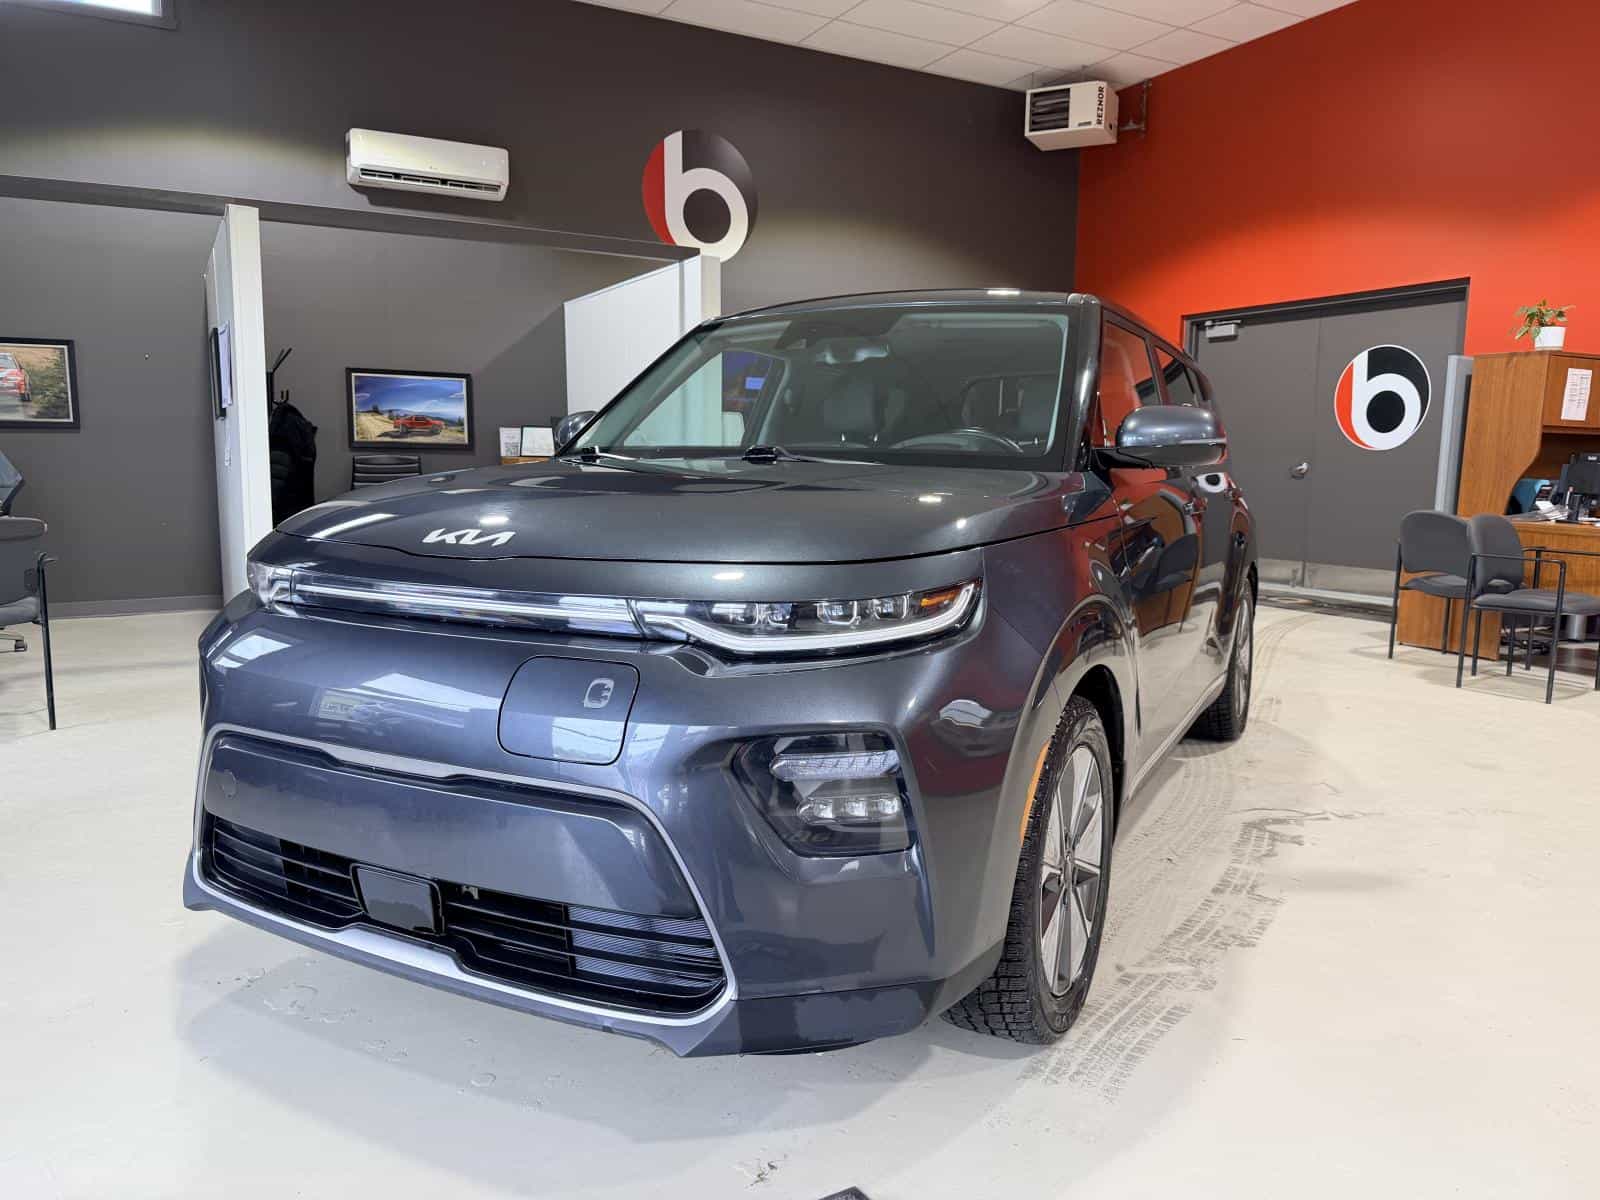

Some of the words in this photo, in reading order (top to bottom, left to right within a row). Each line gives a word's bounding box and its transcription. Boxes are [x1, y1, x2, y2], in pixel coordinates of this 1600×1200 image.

[1096, 86, 1105, 125] REZNOR
[664, 130, 749, 263] b
[1351, 349, 1421, 450] b
[422, 528, 517, 547] KIA
